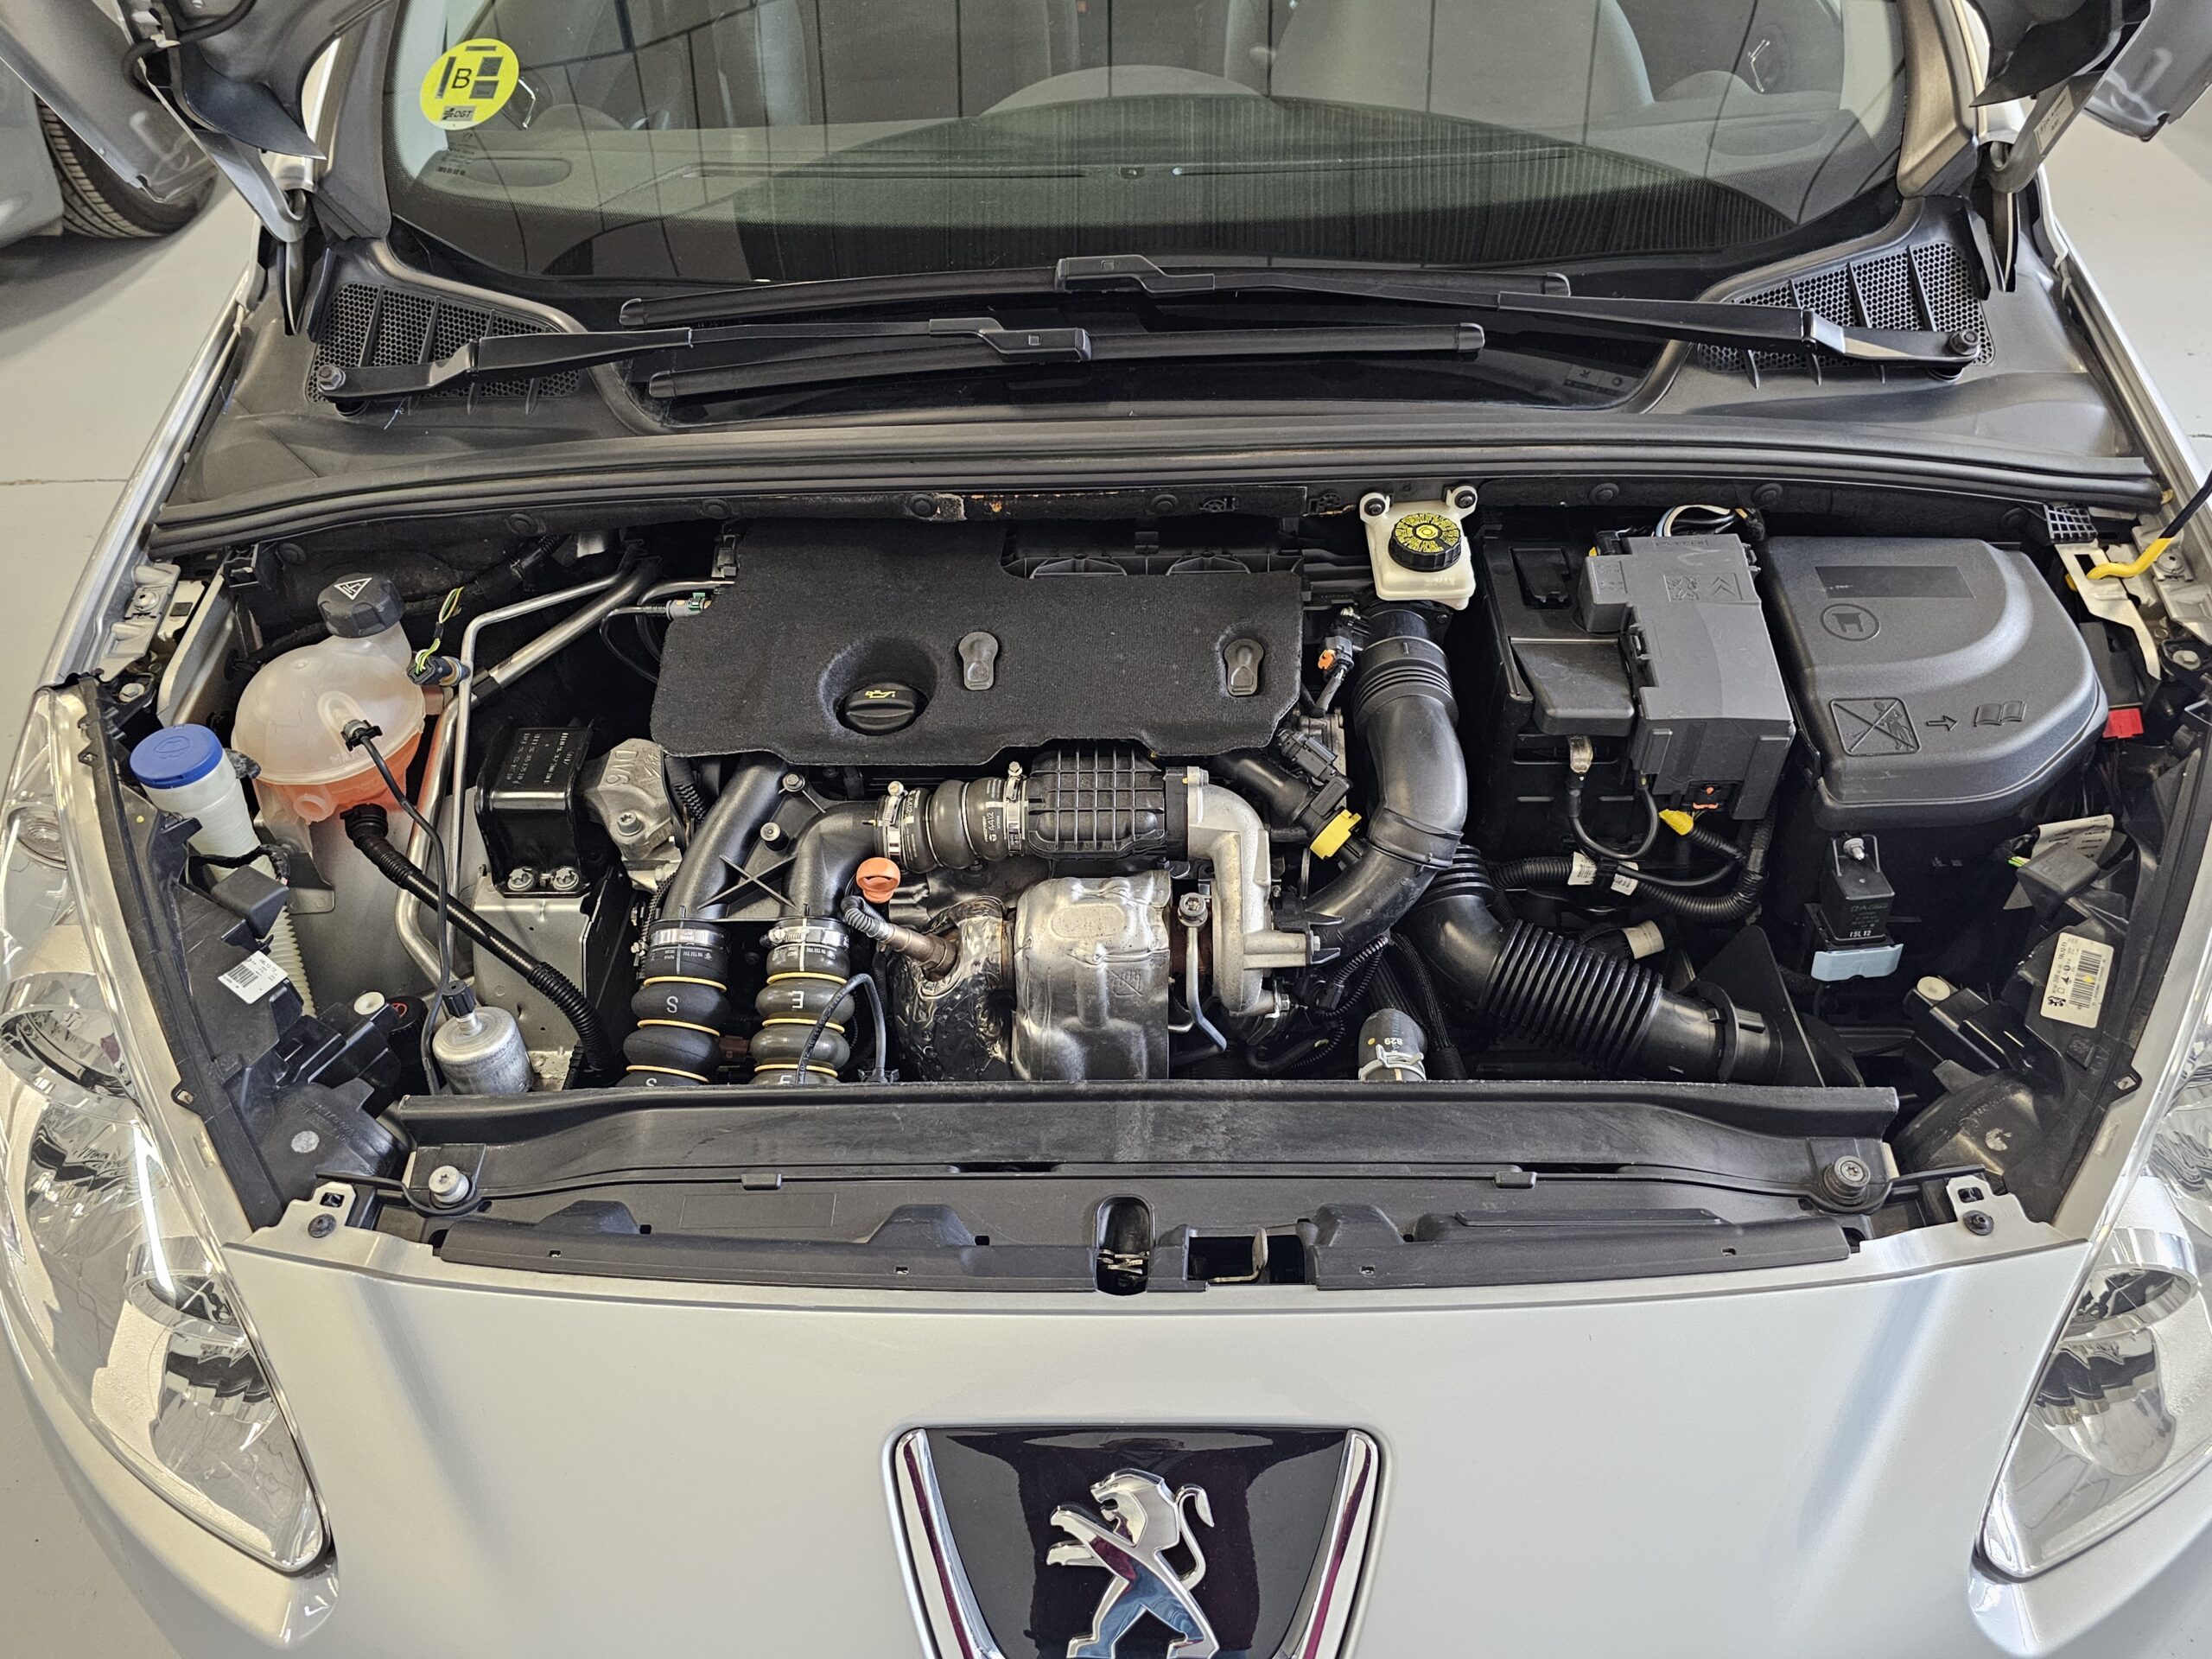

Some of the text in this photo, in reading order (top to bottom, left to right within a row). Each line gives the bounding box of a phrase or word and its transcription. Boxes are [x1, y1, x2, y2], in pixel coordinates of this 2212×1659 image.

[451, 68, 473, 89] B
[453, 110, 474, 118] DGT
[605, 749, 639, 785] DV6
[666, 995, 679, 1014] S
[1383, 1037, 1403, 1046] 829
